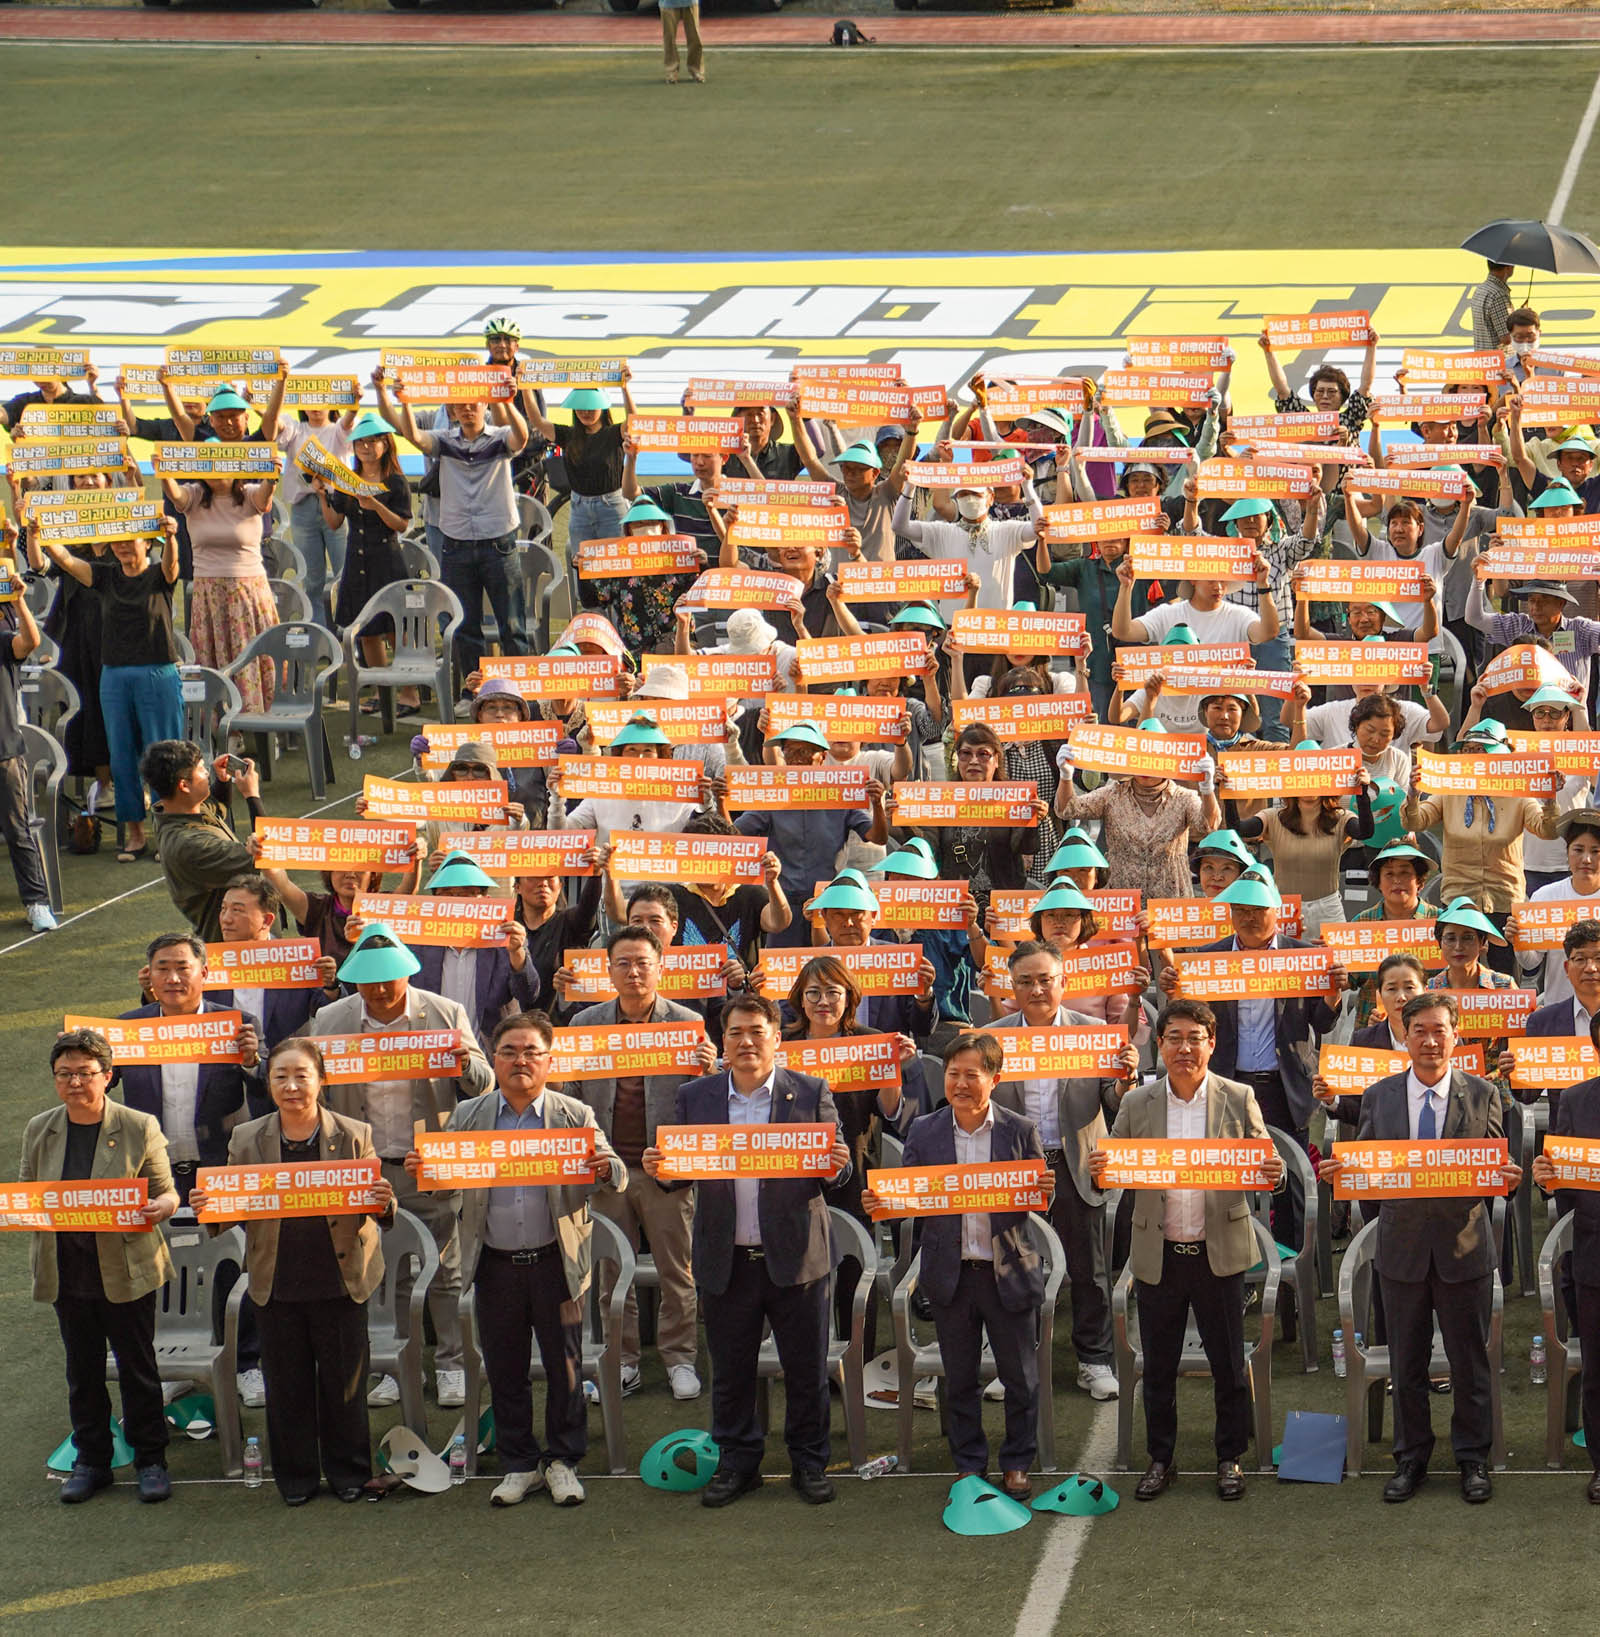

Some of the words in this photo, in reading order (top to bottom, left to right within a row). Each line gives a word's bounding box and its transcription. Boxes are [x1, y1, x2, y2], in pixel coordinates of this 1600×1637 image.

[1266, 319, 1289, 334] 34년
[1319, 314, 1367, 330] 이루어진다
[1312, 330, 1350, 344] 의과대학
[1349, 328, 1368, 341] 신설
[630, 418, 654, 432] 34년
[687, 419, 740, 435] 이루어진다
[679, 434, 720, 449] 의과대학
[720, 434, 742, 448] 신설
[162, 447, 196, 459] 전남권
[198, 447, 246, 459] 의과대학
[247, 447, 272, 459] 신설
[40, 510, 78, 525] 전남권
[79, 506, 129, 522] 의과대학
[131, 504, 156, 517] 신설
[956, 614, 983, 630] 34년
[1021, 616, 1081, 633] 이루어진다
[1011, 633, 1057, 649] 의과대학
[614, 837, 645, 855] 34년
[691, 839, 761, 858] 이루어진다
[613, 857, 678, 875] 국립목포대
[680, 859, 733, 876] 의과대학
[733, 859, 761, 877] 신설
[421, 1140, 457, 1160] 34년
[509, 1136, 589, 1158] 이루어진다
[662, 1133, 699, 1152] 34년
[750, 1130, 830, 1151] 이루어진다
[662, 1154, 737, 1173] 국립목포대
[739, 1153, 799, 1171] 의과대학
[801, 1152, 831, 1170] 신설
[1425, 1146, 1502, 1168] 이루어진다
[203, 1173, 241, 1192] 34년
[293, 1166, 374, 1189] 이루어진다
[422, 1161, 497, 1181] 국립목포대
[498, 1159, 560, 1178] 의과대학
[1102, 1169, 1177, 1184] 국립목포대
[1179, 1169, 1238, 1185] 의과대학
[1339, 1171, 1412, 1191] 국립목포대
[1415, 1169, 1473, 1188] 의과대학
[876, 1177, 911, 1194] 34년
[283, 1190, 345, 1209] 의과대학
[951, 1191, 1011, 1209] 의과대학
[1012, 1189, 1043, 1207] 신설
